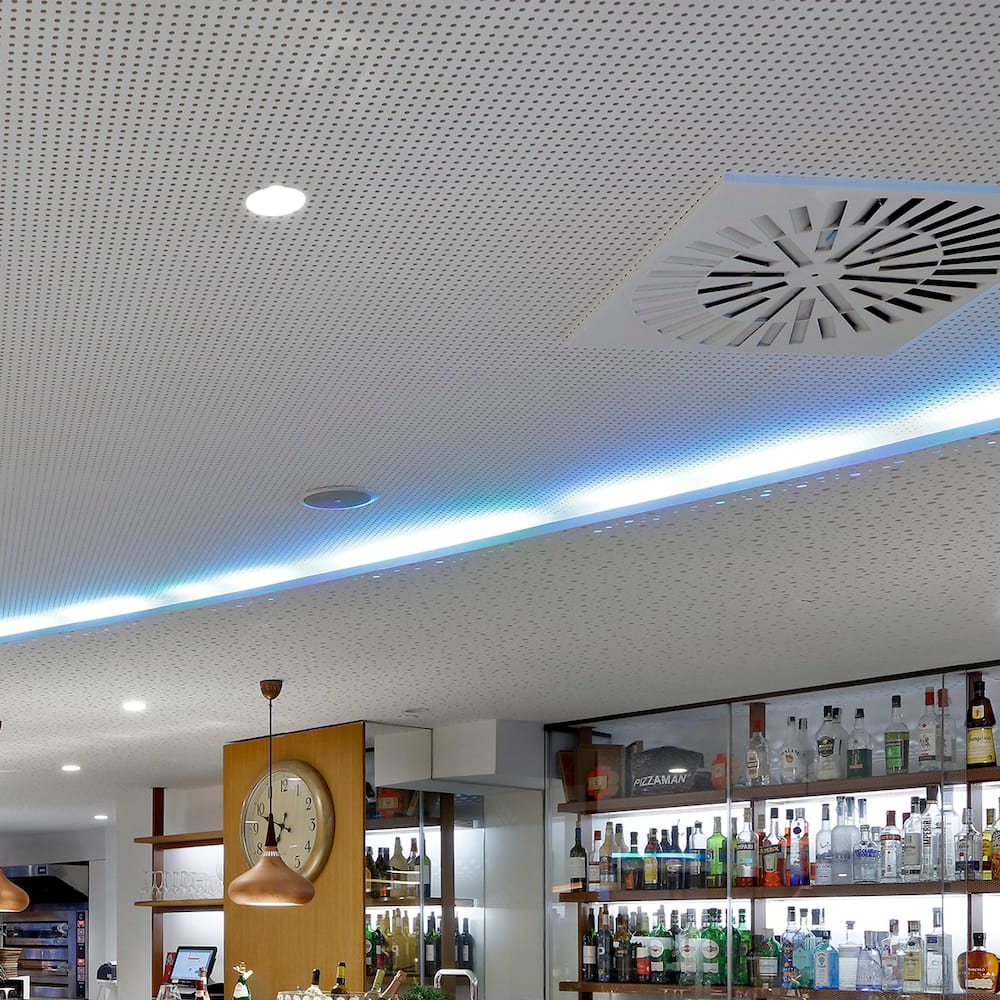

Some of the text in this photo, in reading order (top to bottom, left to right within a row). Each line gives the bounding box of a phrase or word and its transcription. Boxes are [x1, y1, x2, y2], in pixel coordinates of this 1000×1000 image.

[280, 779, 288, 792] 12
[256, 802, 265, 816] 10
[305, 797, 312, 811] 2
[309, 818, 316, 832] 3
[256, 842, 263, 855] 8
[304, 840, 312, 853] 4
[294, 855, 301, 868] 5
